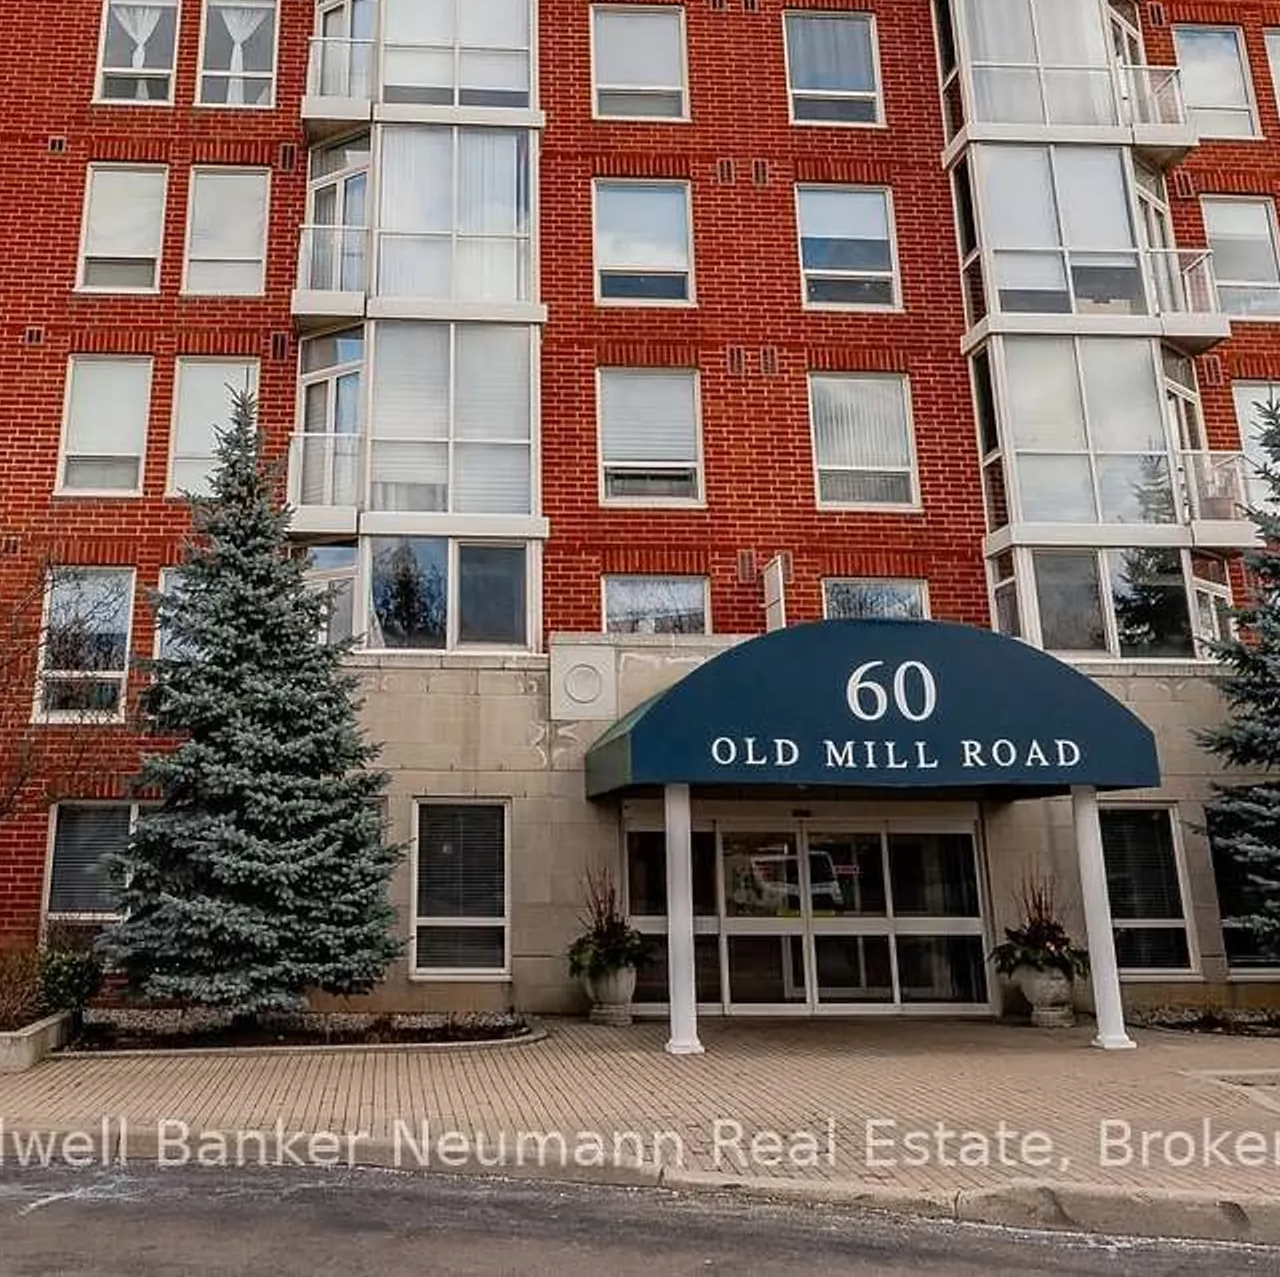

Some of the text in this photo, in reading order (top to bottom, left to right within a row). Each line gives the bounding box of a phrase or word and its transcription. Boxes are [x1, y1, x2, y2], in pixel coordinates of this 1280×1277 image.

[845, 659, 938, 722] 60
[710, 736, 1082, 769] OLD MILL ROAD
